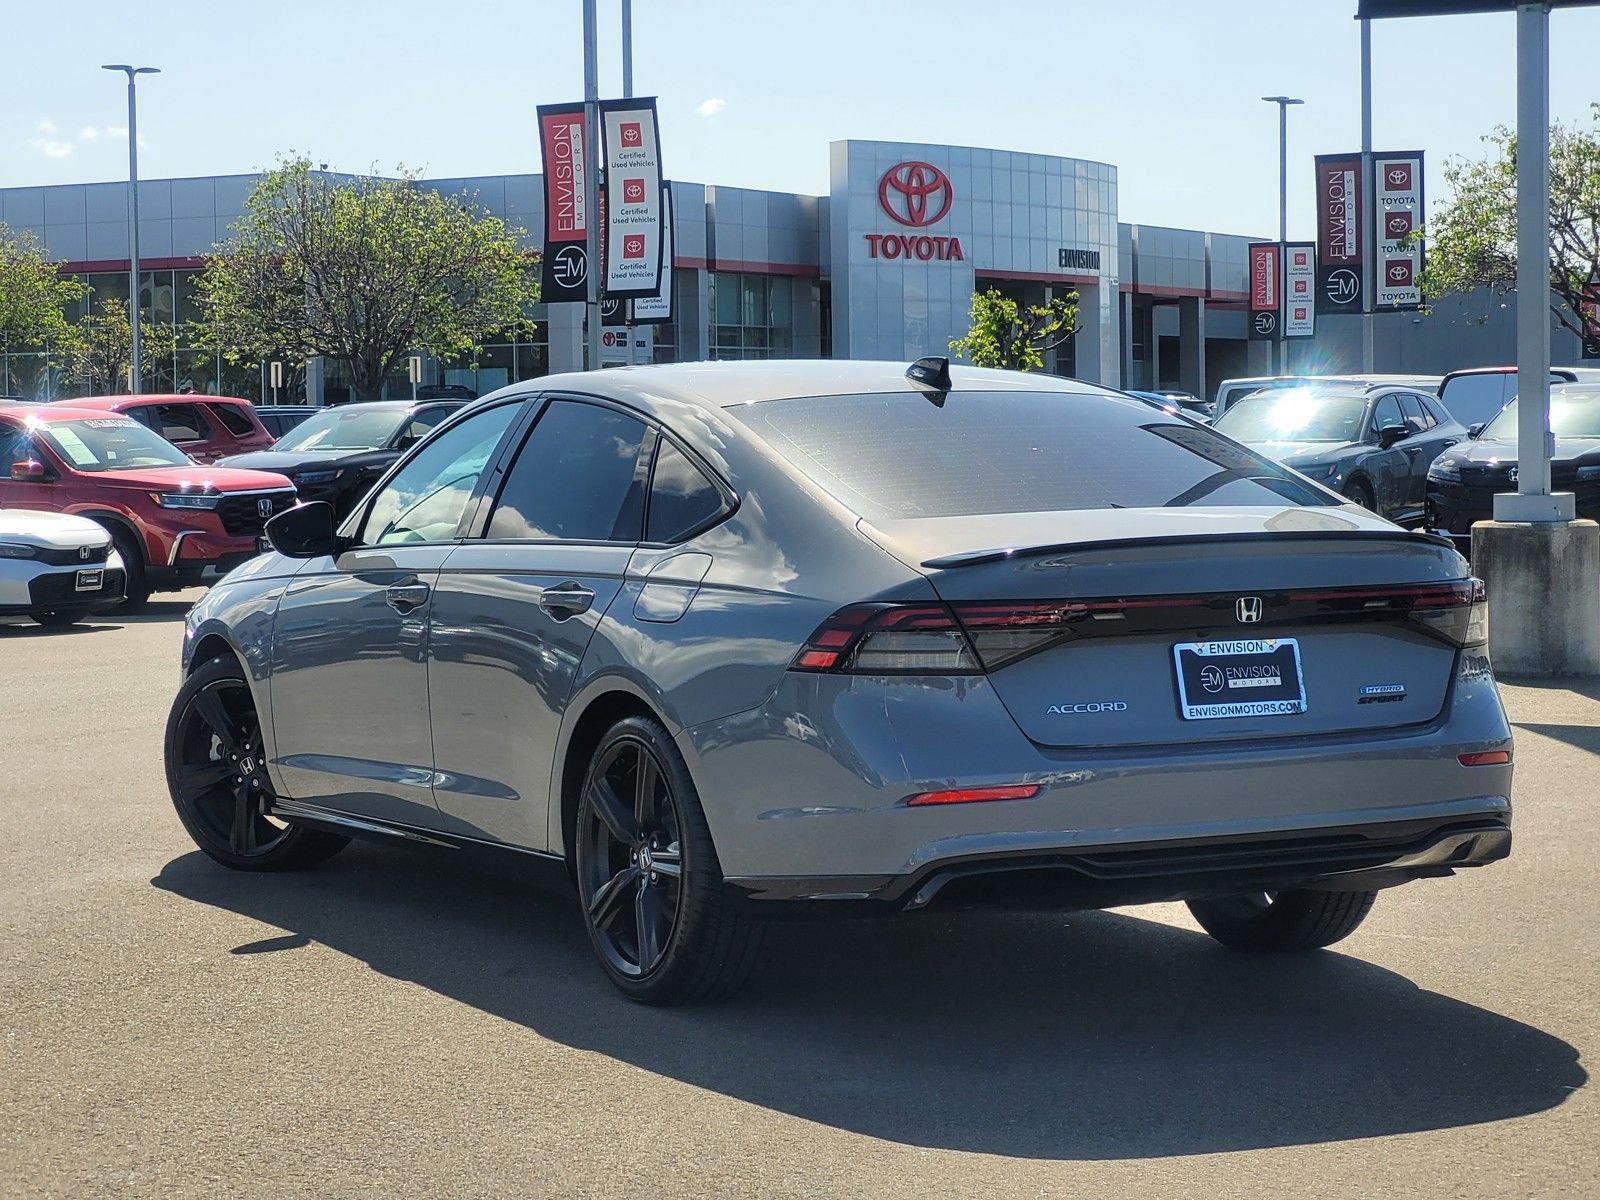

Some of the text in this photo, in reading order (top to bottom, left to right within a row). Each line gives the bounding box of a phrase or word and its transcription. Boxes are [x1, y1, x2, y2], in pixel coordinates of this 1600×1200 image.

[619, 152, 646, 160] Certified
[552, 124, 574, 231] ENVISION
[573, 133, 584, 221] MOTORS
[1381, 197, 1416, 206] TOYOTA
[1329, 171, 1345, 257] ENVISION
[1346, 178, 1354, 249] MOTORS
[864, 235, 965, 260] TOYOTA
[1381, 245, 1416, 254] TOYOTA
[1058, 248, 1101, 270] ENVISION
[1256, 252, 1266, 306] ENVISION
[1381, 292, 1417, 301] TOYOTA
[1209, 641, 1264, 654] ENVISION
[1226, 665, 1281, 679] ENVISION
[1232, 678, 1278, 686] MOTORS
[1357, 693, 1407, 705] SPORT
[1046, 701, 1127, 715] ACCORD
[1189, 701, 1302, 717] ENVISIONMOTORS.COM
